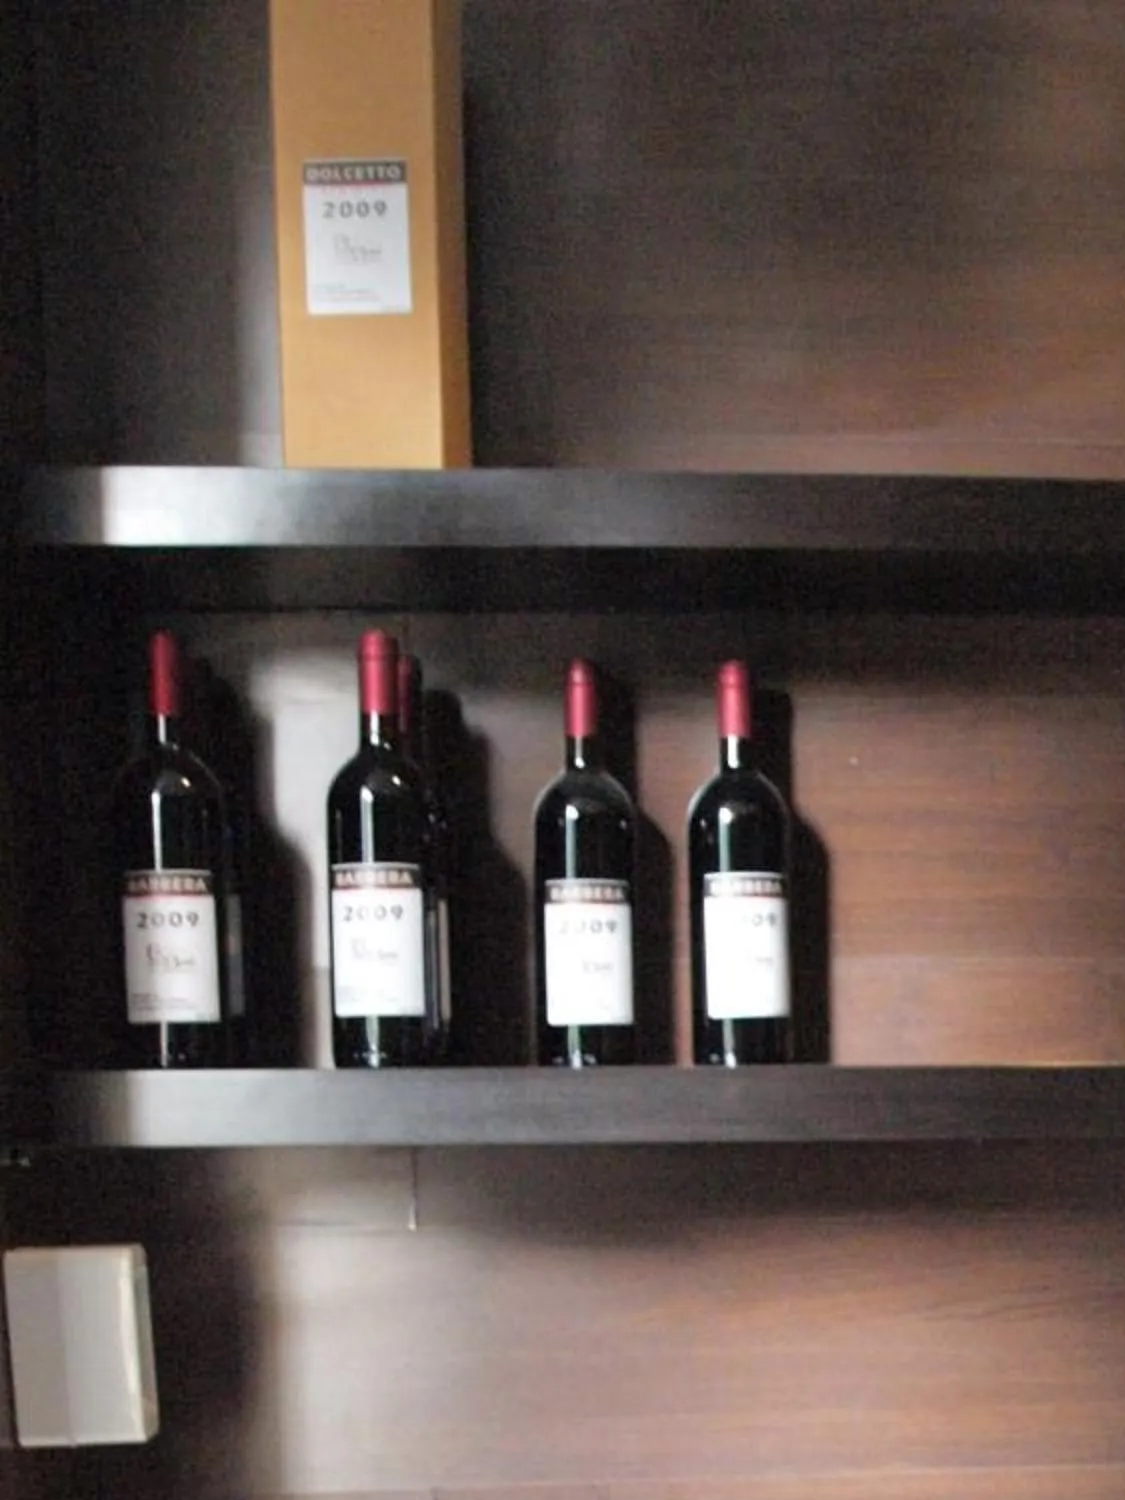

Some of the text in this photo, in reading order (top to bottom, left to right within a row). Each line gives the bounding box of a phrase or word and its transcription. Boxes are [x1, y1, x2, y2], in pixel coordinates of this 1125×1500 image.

[305, 165, 402, 181] DOLCETTO
[322, 200, 388, 219] 2009
[136, 910, 200, 929] 2009
